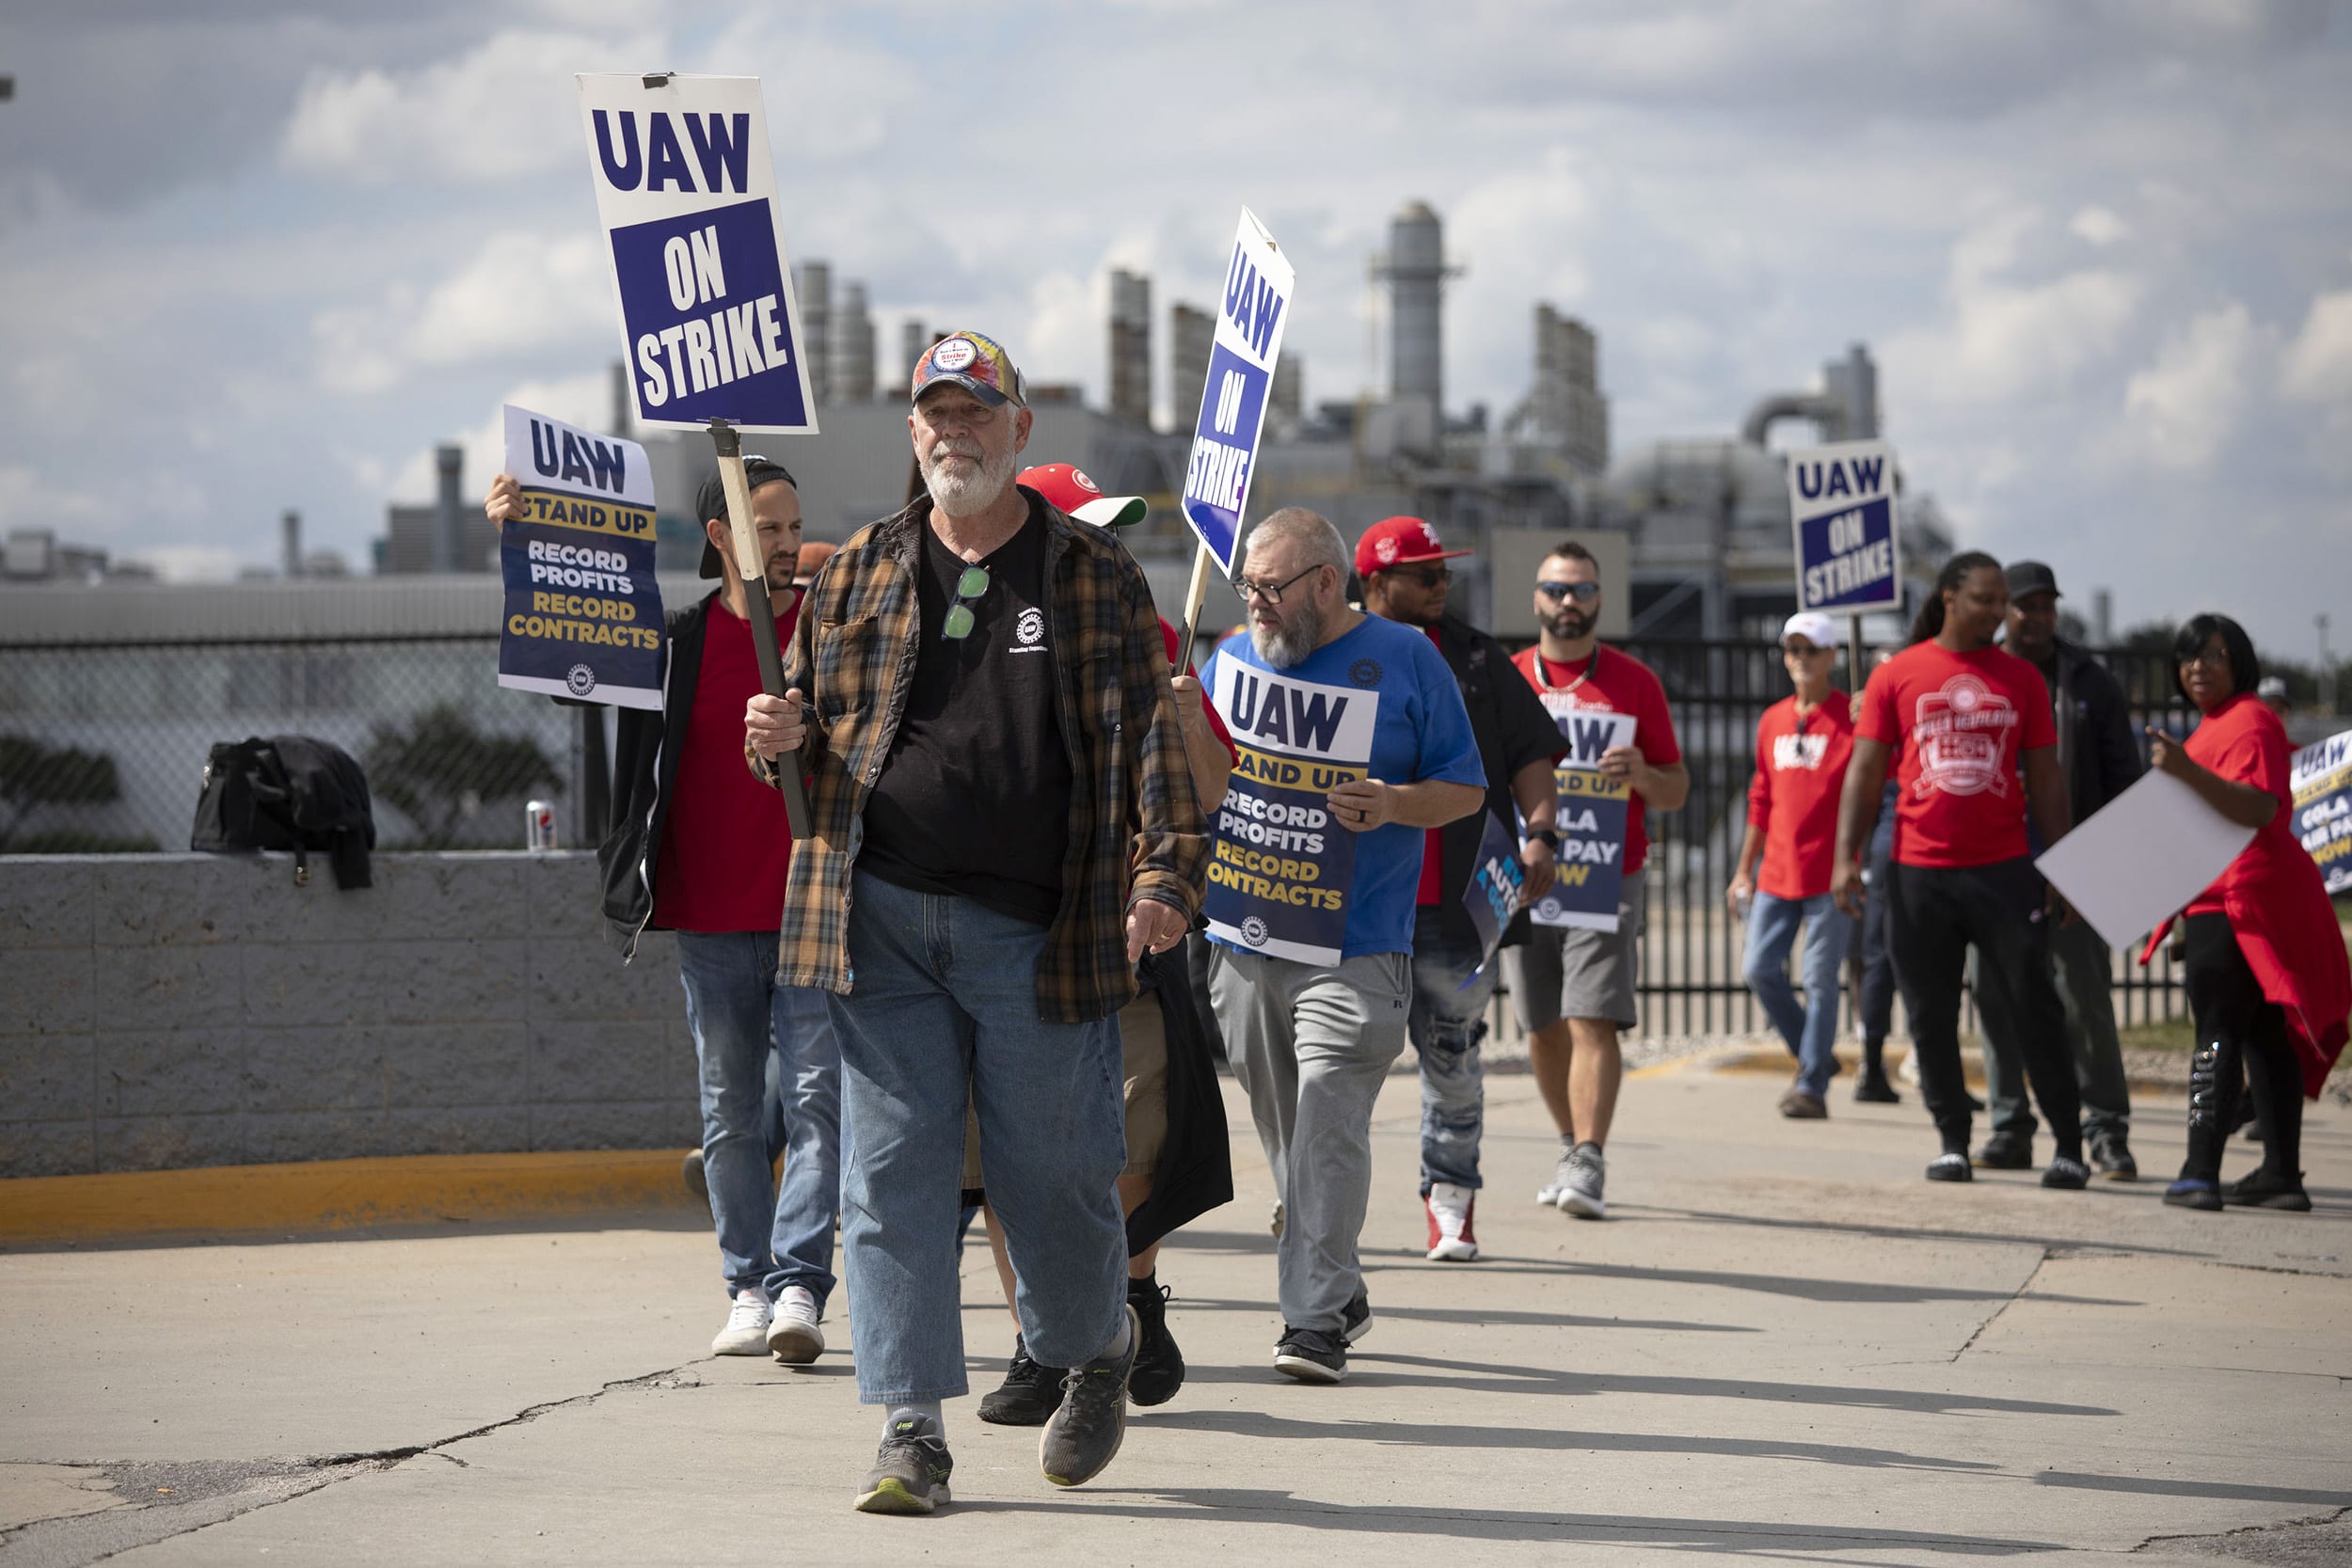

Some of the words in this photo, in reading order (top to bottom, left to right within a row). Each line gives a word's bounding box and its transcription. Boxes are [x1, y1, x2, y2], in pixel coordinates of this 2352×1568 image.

[592, 109, 750, 194] UAW
[663, 225, 727, 312] ON
[1225, 241, 1283, 361] UAW
[637, 293, 788, 407] STRIKE
[1215, 369, 1247, 436] ON
[531, 419, 626, 495] UAW
[1187, 436, 1249, 513] STRIKE
[1798, 455, 1883, 499] UAW
[615, 510, 648, 534] UP
[1827, 508, 1866, 557] ON
[528, 540, 628, 573] RECORD
[1805, 536, 1891, 606] STRIKE
[531, 563, 634, 594] PROFITS
[533, 591, 636, 622] RECORD
[508, 614, 660, 650] CONTRACTS
[1231, 670, 1349, 752] UAW
[1239, 753, 1301, 784] AND
[2301, 739, 2346, 778] UAW
[1224, 788, 1327, 829] RECORD
[1555, 807, 1599, 832] LA
[2301, 796, 2350, 831] COLA
[1218, 811, 1325, 855] PROFITS
[1563, 838, 1620, 864] PAY
[2301, 826, 2329, 854] AIR
[2330, 814, 2352, 841] PA
[2311, 833, 2352, 867] NOW
[1215, 839, 1320, 882] RECORD
[1207, 861, 1343, 911] ONTRACTS
